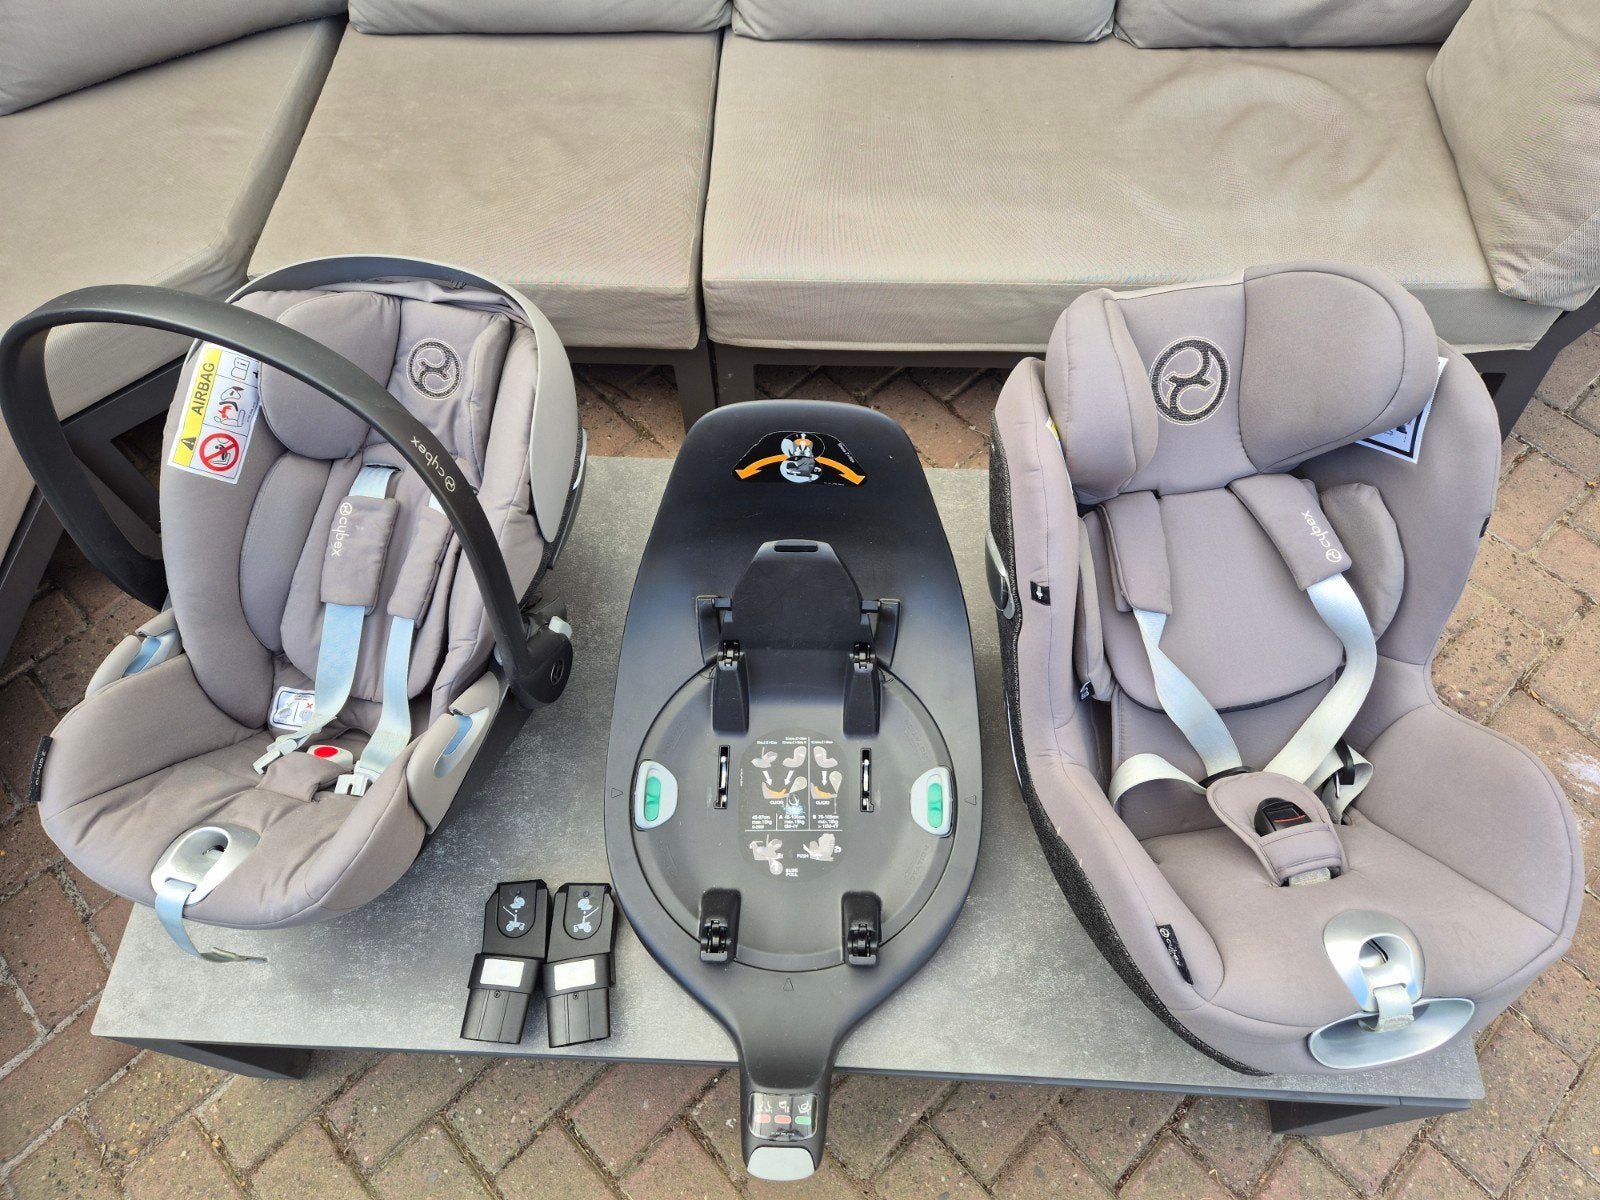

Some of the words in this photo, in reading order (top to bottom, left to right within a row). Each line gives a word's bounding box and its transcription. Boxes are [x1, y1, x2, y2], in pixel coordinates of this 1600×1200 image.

[191, 362, 215, 415] AIRBAG
[410, 435, 445, 477] cybex
[331, 516, 350, 557] cybex
[1300, 510, 1331, 548] cybex
